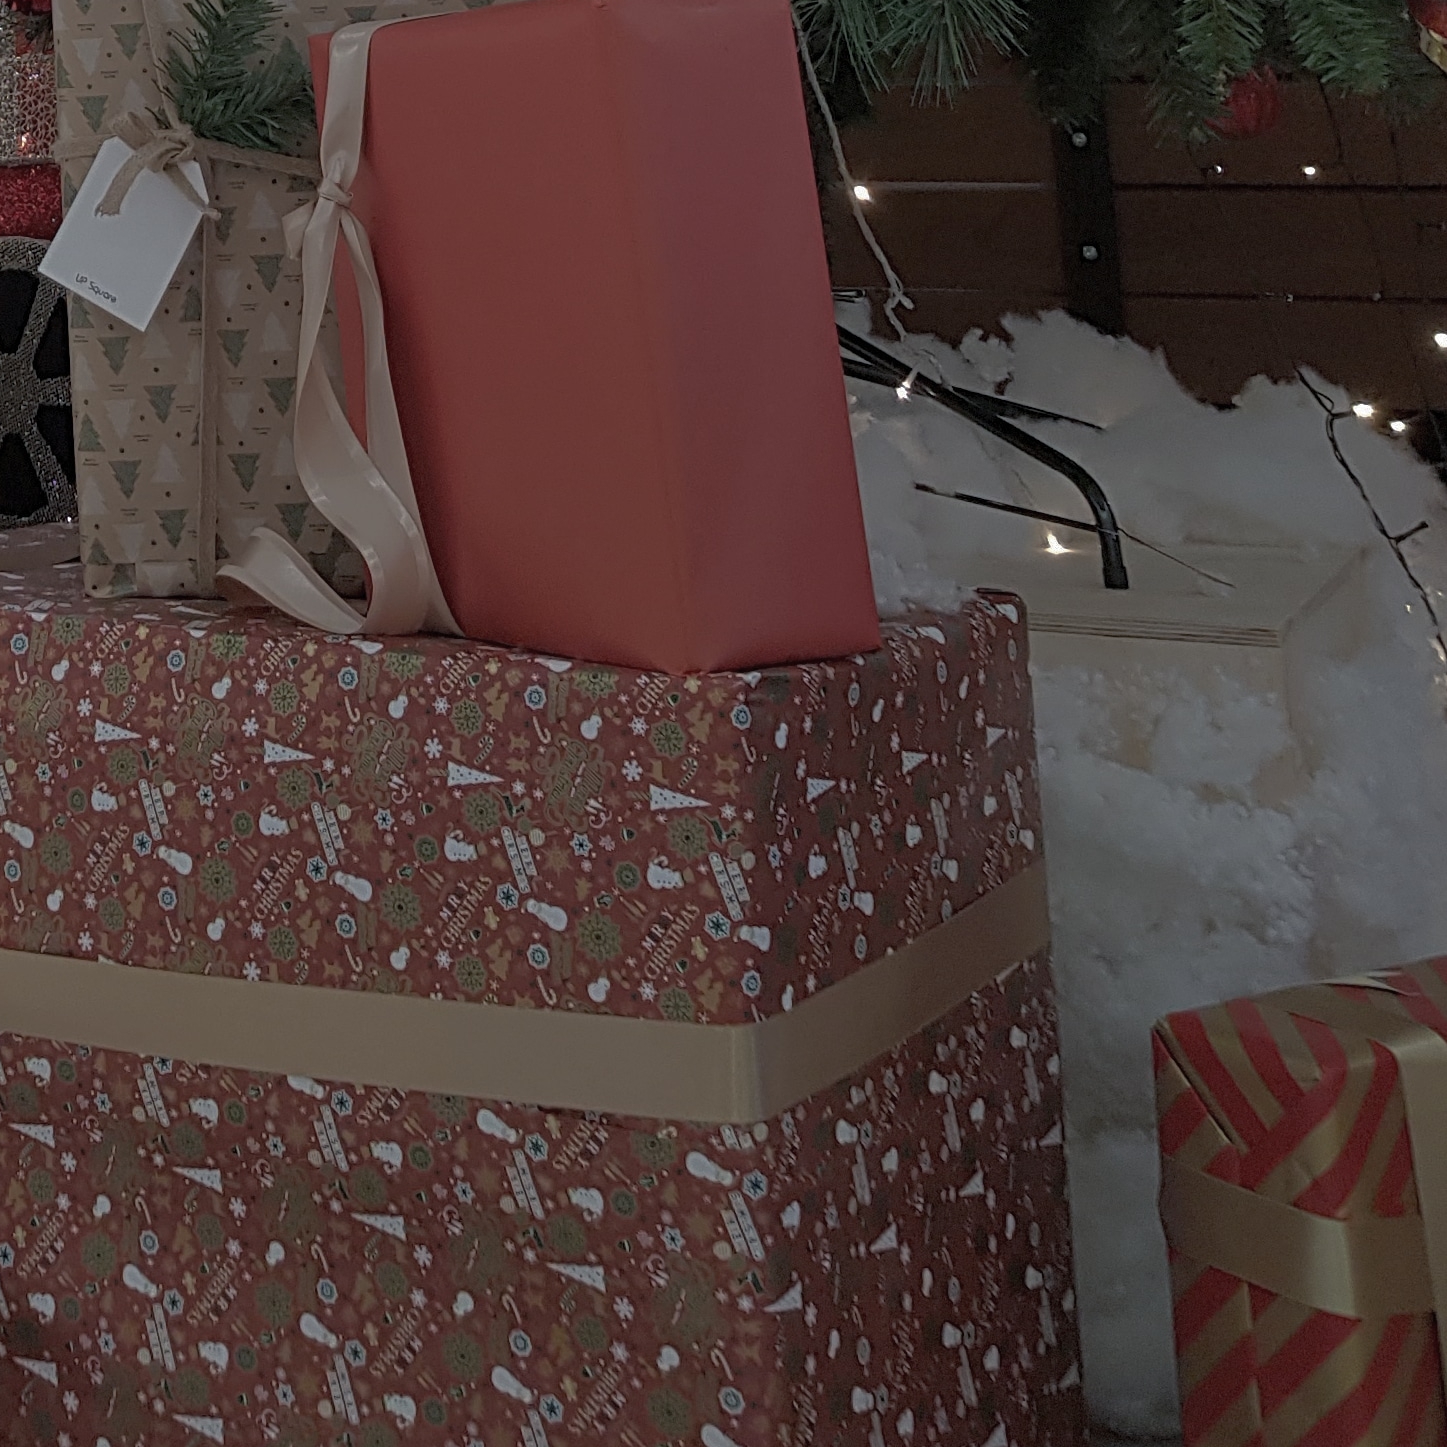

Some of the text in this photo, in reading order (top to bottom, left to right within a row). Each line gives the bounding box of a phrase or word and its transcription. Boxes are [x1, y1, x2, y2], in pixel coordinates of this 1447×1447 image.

[88, 281, 117, 303] Square
[88, 822, 130, 891] CHRISTMAS
[254, 848, 303, 919] CHRISTMAS
[440, 874, 492, 948] CHRISTMAS
[644, 902, 700, 979] CHRISTMAS
